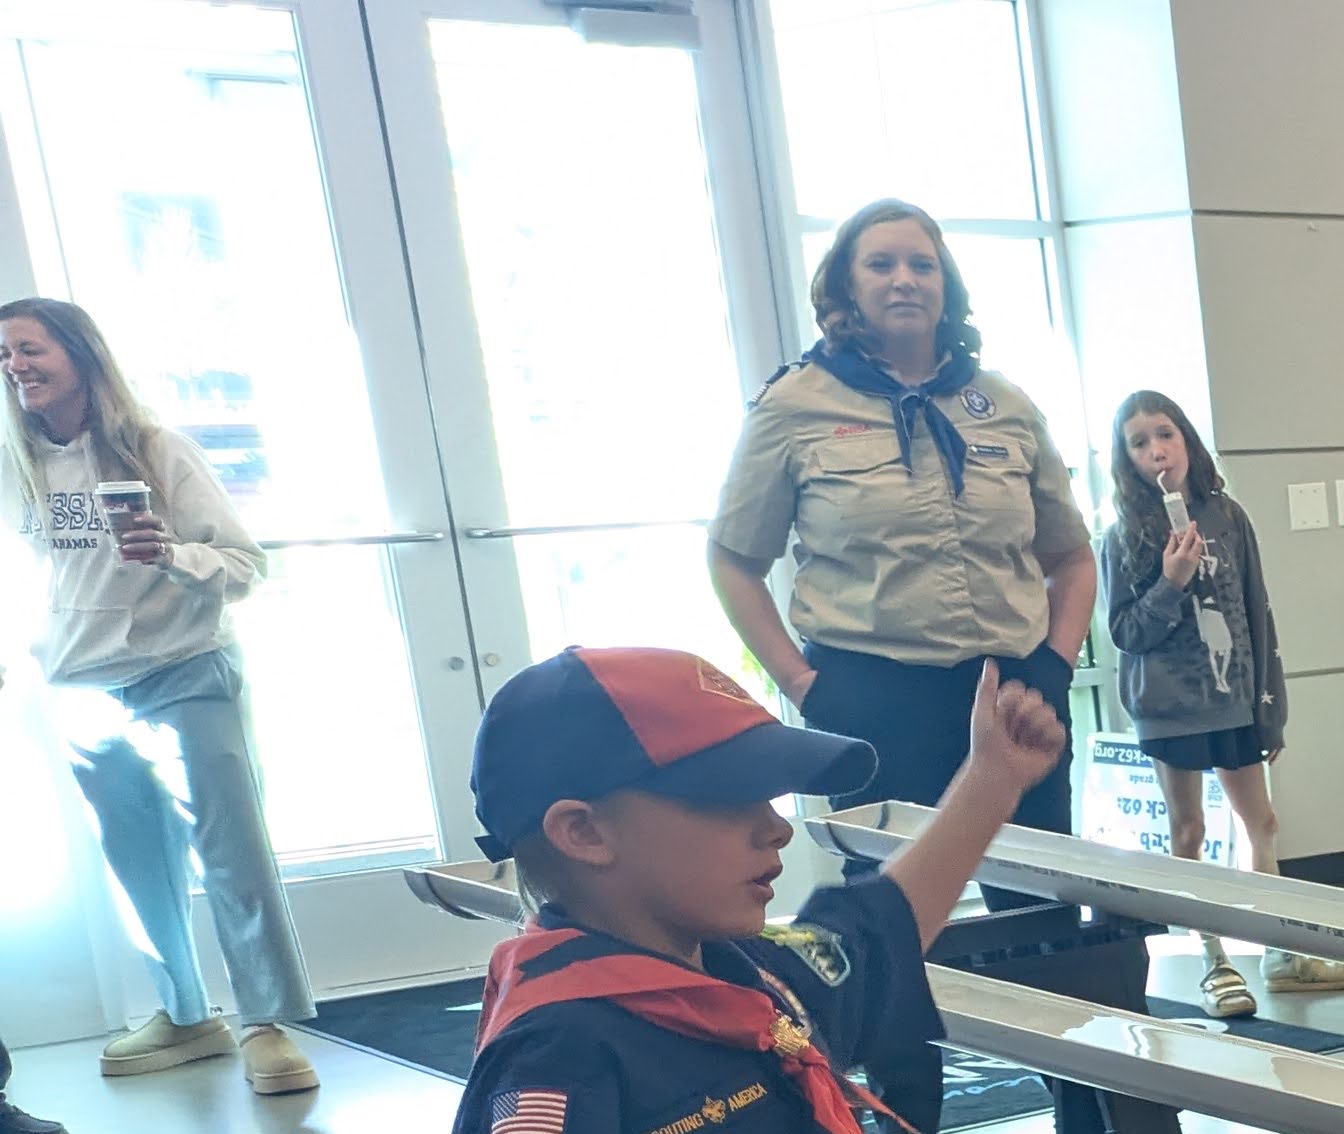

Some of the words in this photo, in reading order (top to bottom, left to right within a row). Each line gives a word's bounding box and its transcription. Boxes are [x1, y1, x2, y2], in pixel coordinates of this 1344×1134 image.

[19, 492, 111, 534] NSSA
[44, 537, 98, 550] AHAMAS
[1094, 743, 1153, 764] ck62.org
[727, 1082, 768, 1112] AMERICA
